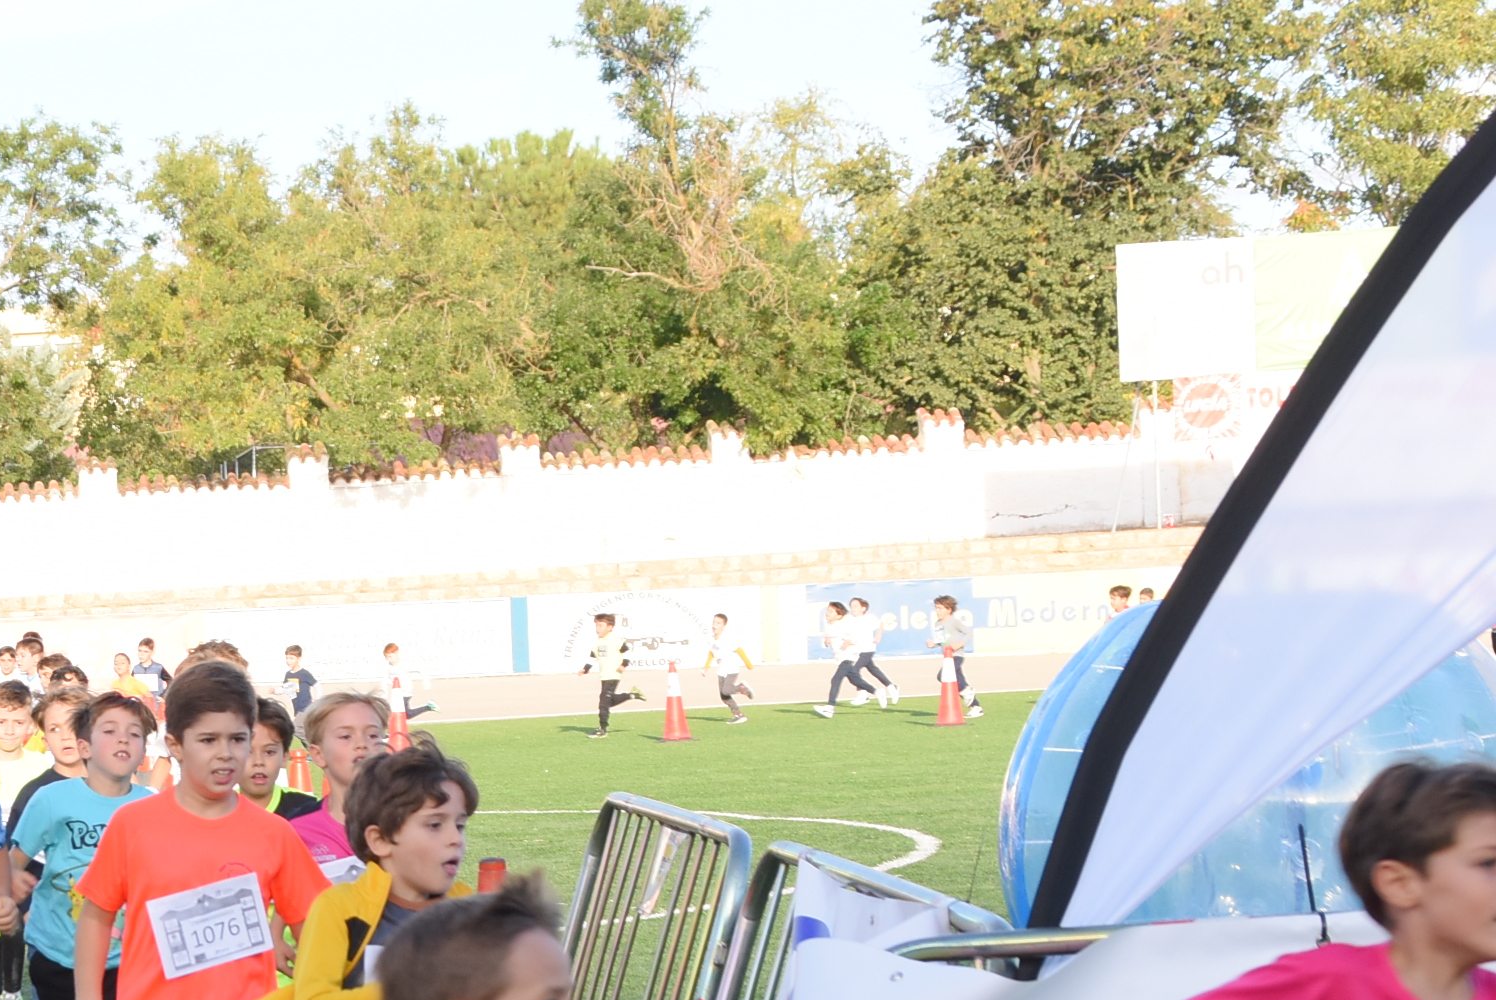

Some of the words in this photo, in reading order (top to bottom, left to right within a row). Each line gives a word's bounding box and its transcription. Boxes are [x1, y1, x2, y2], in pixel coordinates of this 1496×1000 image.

[986, 598, 1113, 627] Modern
[627, 657, 683, 668] MELLOO
[191, 917, 241, 949] 1076
